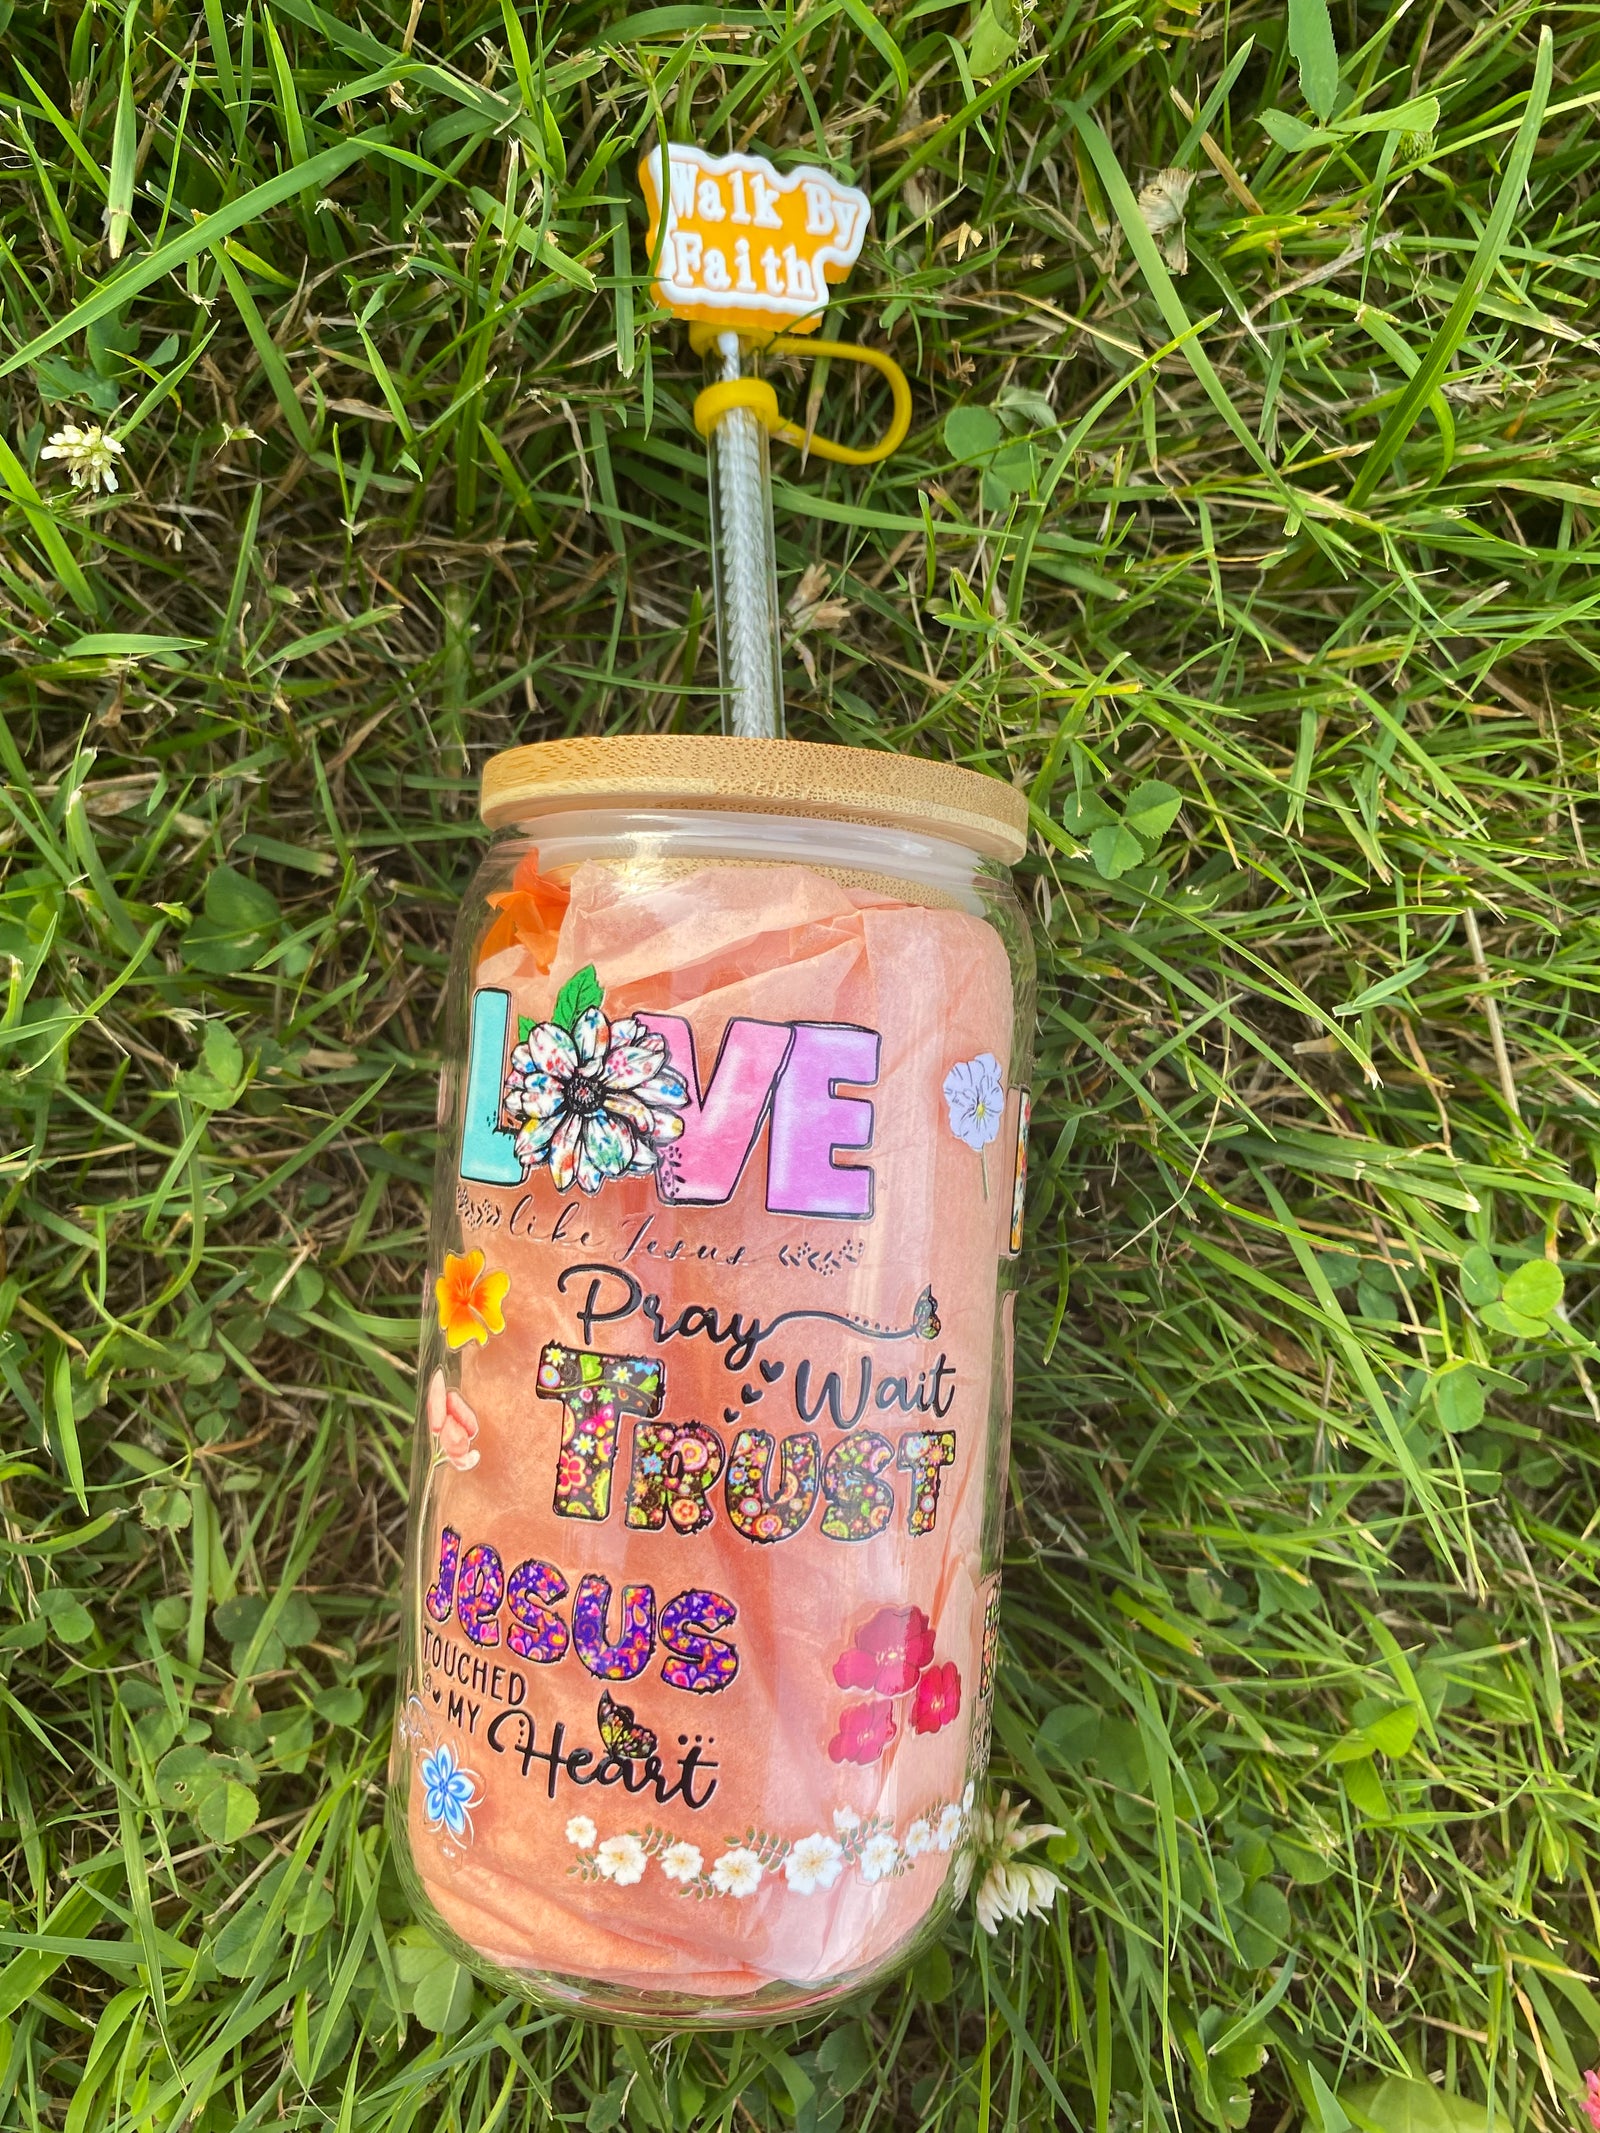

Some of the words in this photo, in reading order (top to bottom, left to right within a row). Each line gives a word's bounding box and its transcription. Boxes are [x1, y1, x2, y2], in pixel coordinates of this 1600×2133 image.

[667, 162, 783, 229] Walk
[802, 181, 858, 250] By
[671, 230, 816, 299] Faith
[459, 986, 883, 1222] LVE
[508, 1193, 604, 1248] like
[616, 1212, 748, 1268] Jesus
[557, 1263, 775, 1372] Pray
[795, 1353, 956, 1429] Wait
[535, 1340, 957, 1544] TRUST
[422, 1625, 527, 1707] TOUCHED
[446, 1694, 481, 1735] MY
[487, 1708, 719, 1810] Heart
